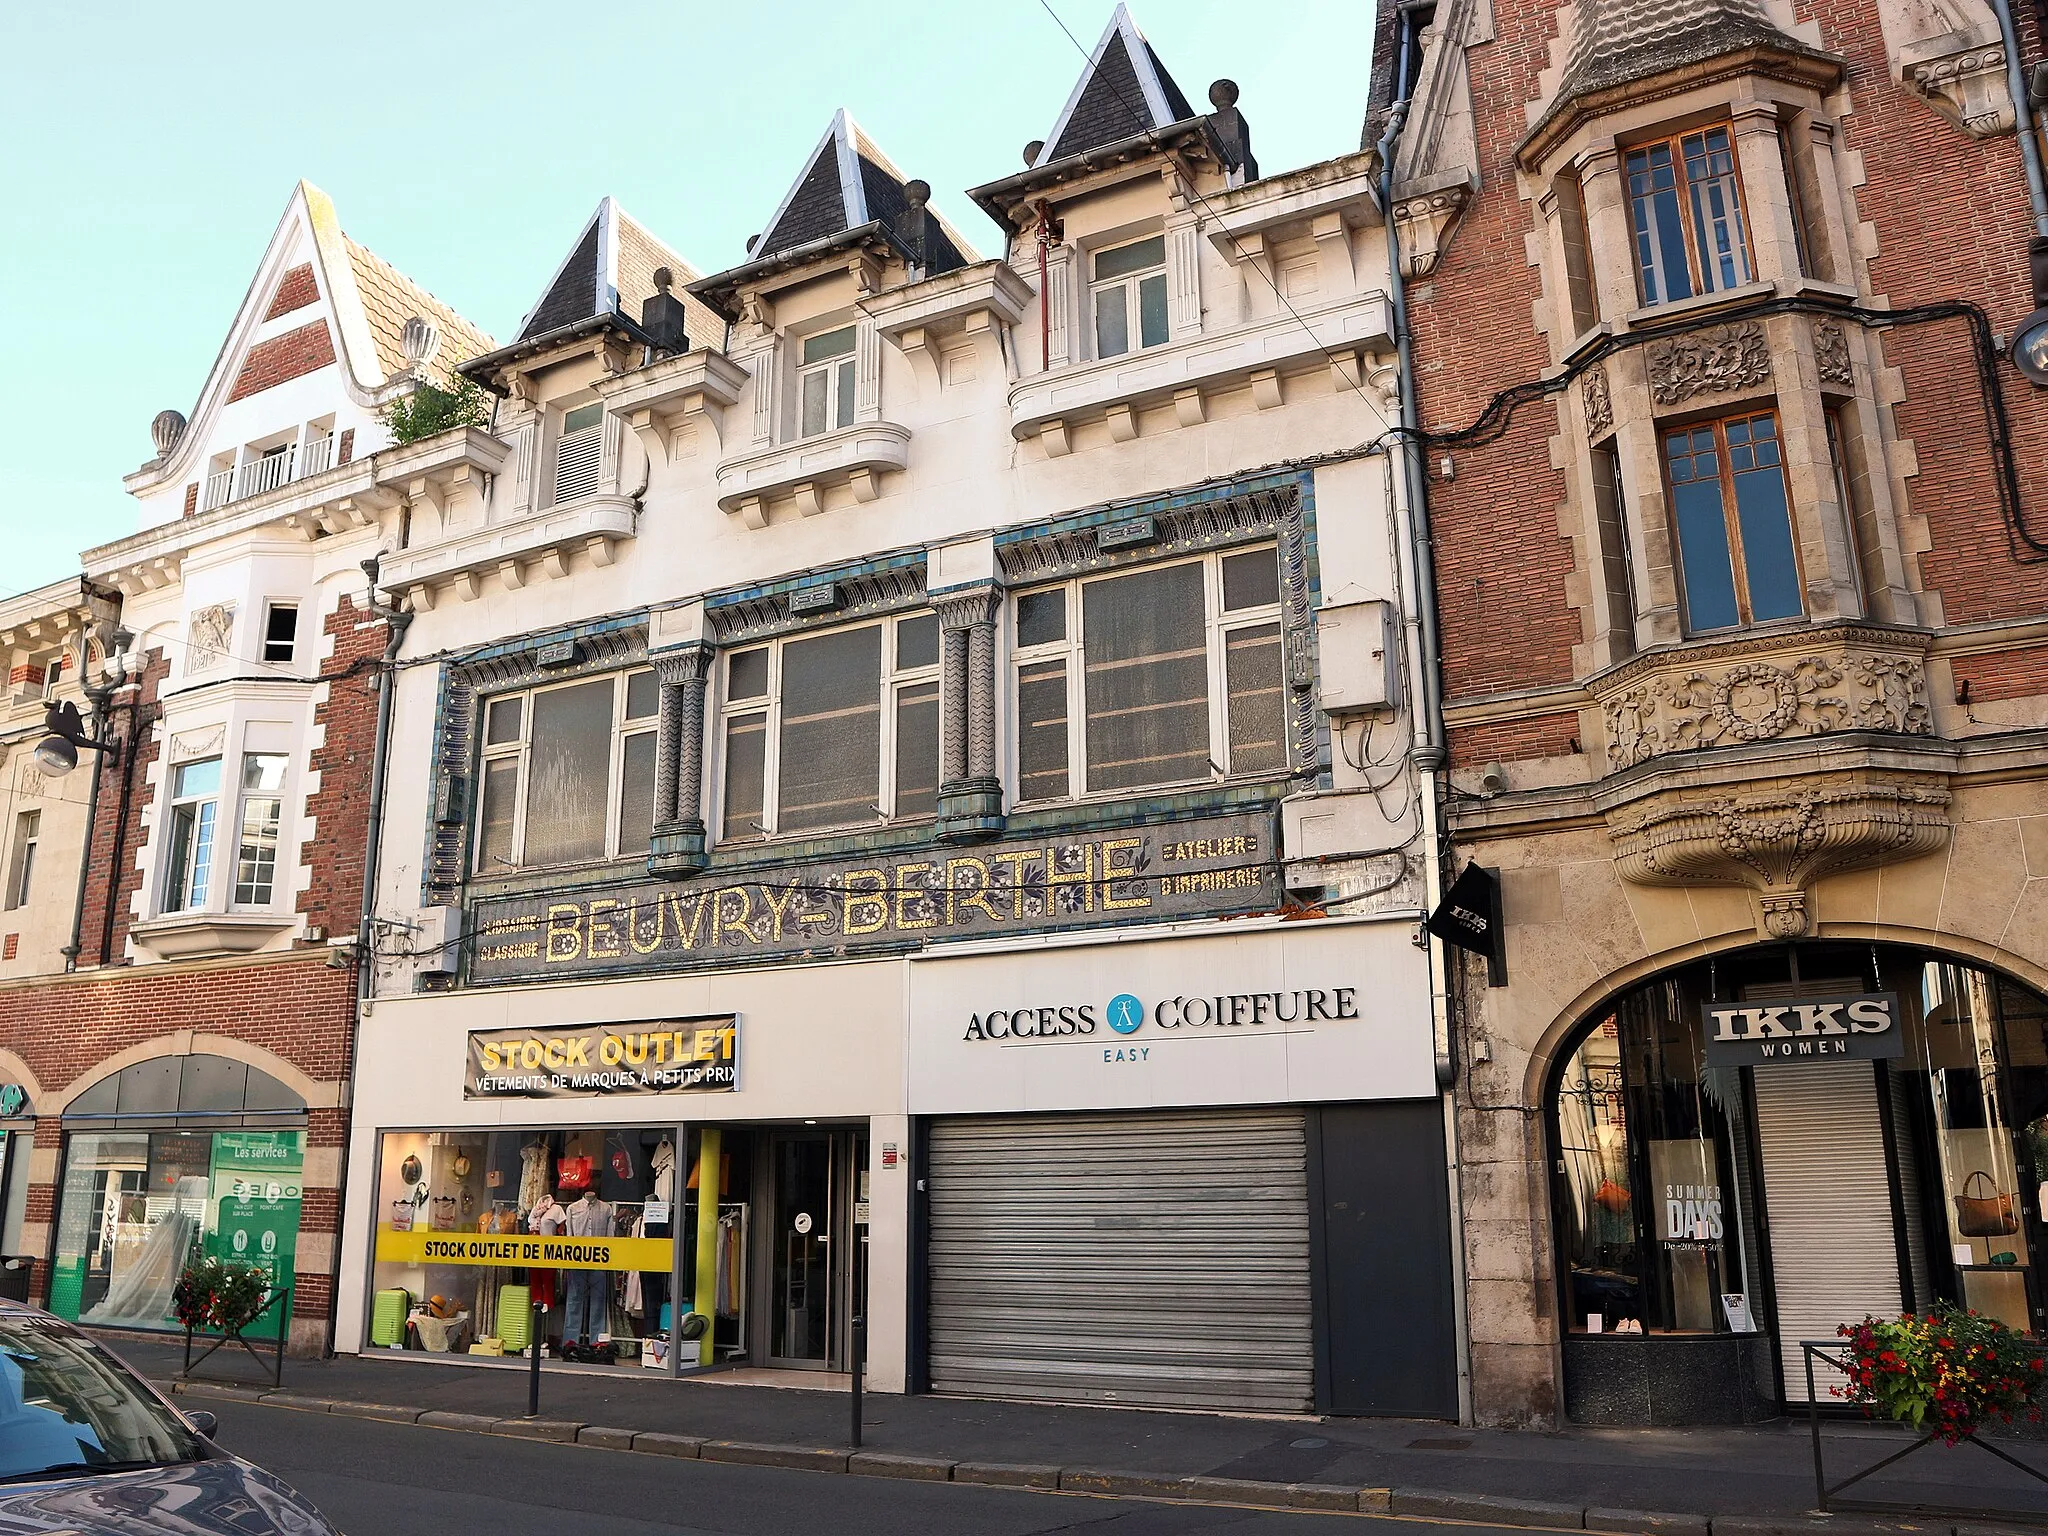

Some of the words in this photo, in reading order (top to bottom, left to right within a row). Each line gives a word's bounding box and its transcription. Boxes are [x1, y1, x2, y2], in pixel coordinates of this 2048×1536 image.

[1175, 836, 1246, 860] ATELIER
[1449, 905, 1487, 930] IKKS
[480, 941, 540, 961] CLASSIQUE
[962, 1004, 1097, 1041] ACCESS
[1153, 987, 1360, 1029] COIFFURE
[1710, 1000, 1892, 1042] IKKS
[480, 1035, 592, 1072] STOCK
[598, 1027, 736, 1067] OUTLET
[1103, 1048, 1151, 1063] EASY
[1761, 1040, 1846, 1057] WOMEN
[475, 1074, 547, 1092] VÊTEMENTS
[551, 1074, 568, 1089] DE
[571, 1070, 635, 1090] MARQUES
[640, 1067, 649, 1086] À
[653, 1067, 701, 1085] PETITS
[234, 1146, 250, 1158] Les
[251, 1146, 287, 1158] services
[1666, 1184, 1720, 1200] SUMMER
[1666, 1199, 1724, 1240] DAYS
[425, 1241, 466, 1258] STOCK
[469, 1242, 519, 1259] OUTLET
[523, 1243, 540, 1260] DE
[543, 1244, 610, 1264] MARQUES
